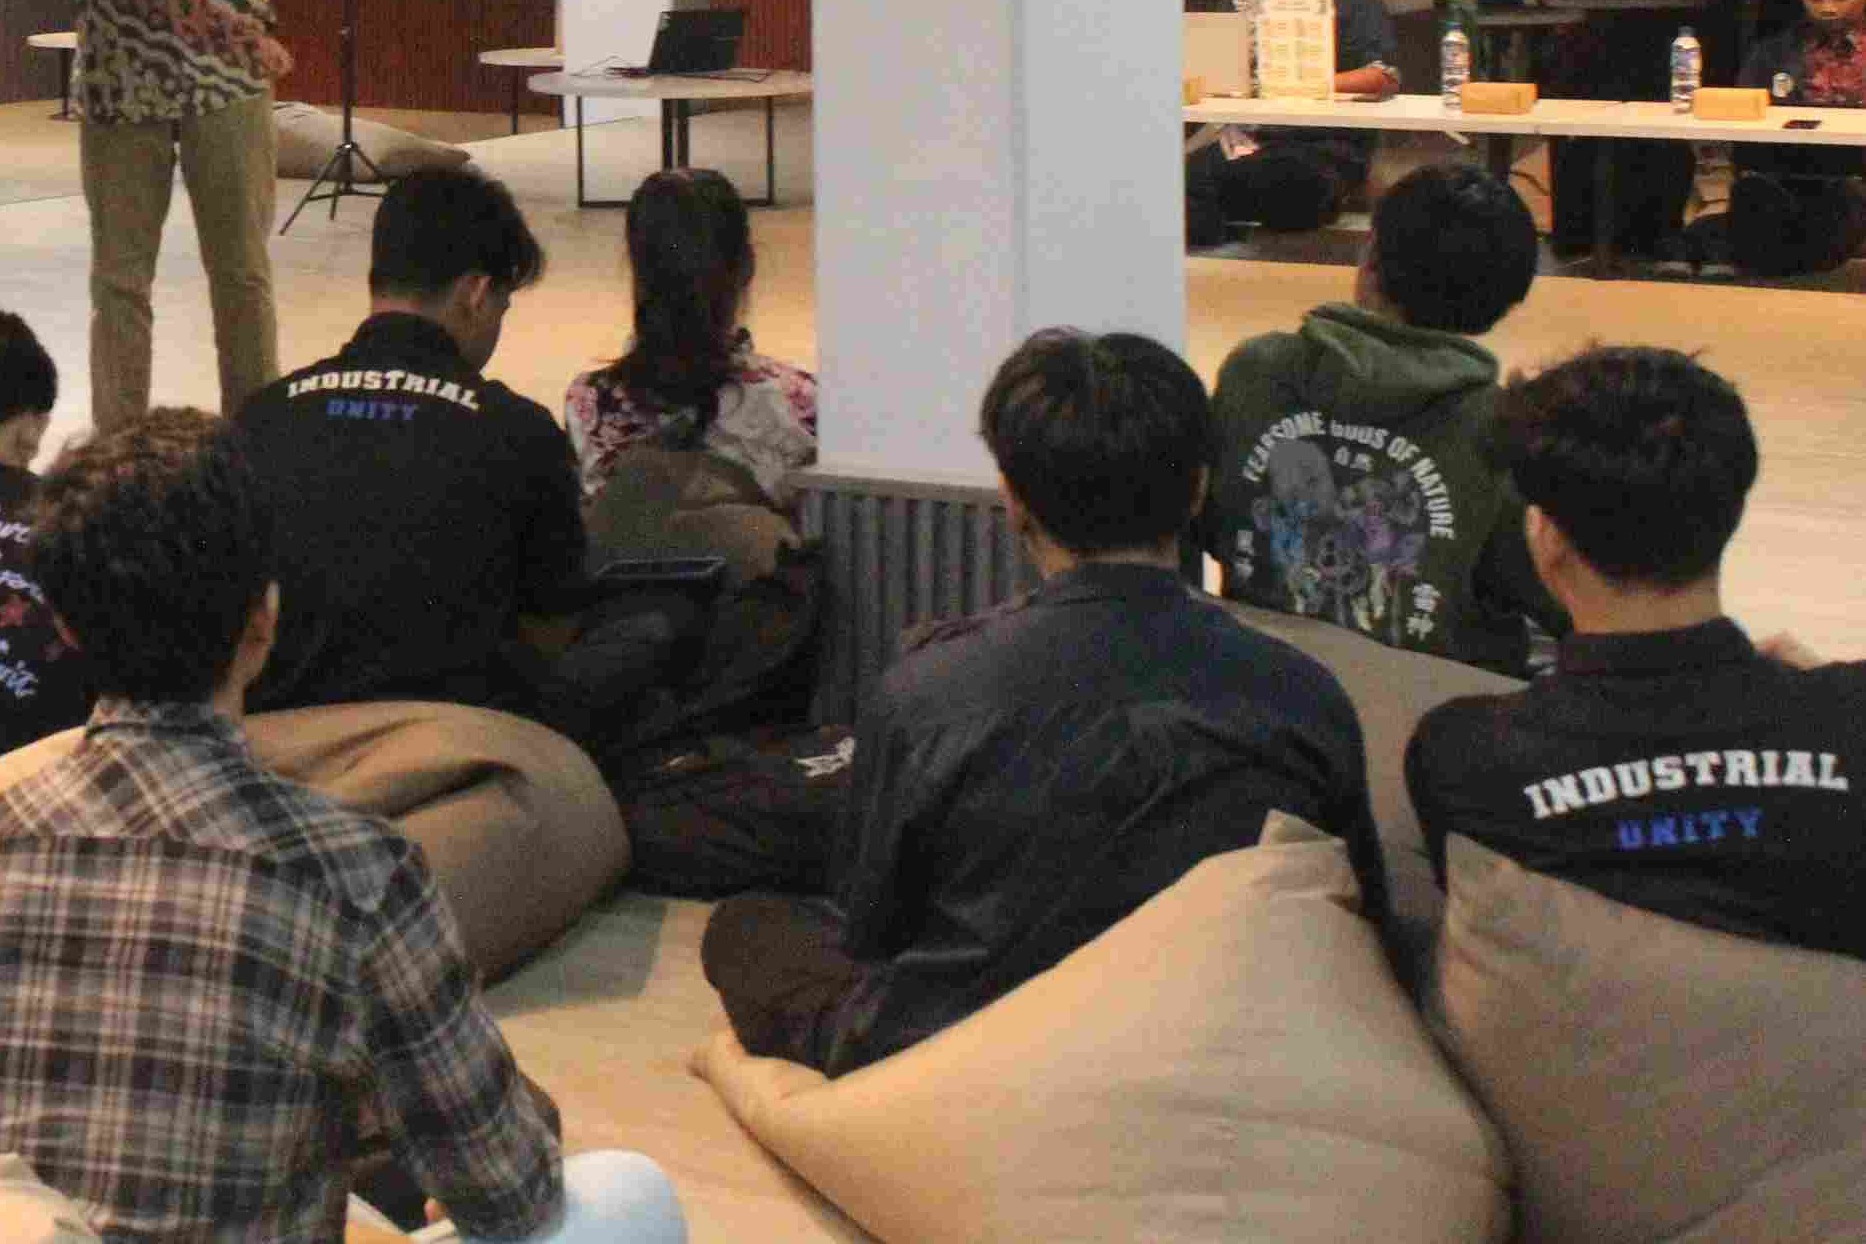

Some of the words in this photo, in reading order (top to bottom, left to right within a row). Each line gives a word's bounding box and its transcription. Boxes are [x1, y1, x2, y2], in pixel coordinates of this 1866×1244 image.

[286, 369, 480, 411] INDUSTRIAL
[326, 399, 420, 421] UNITY
[1410, 457, 1456, 540] NATURE
[1523, 749, 1849, 820] INDUSTRIAL
[1616, 806, 1766, 852] UNITY
